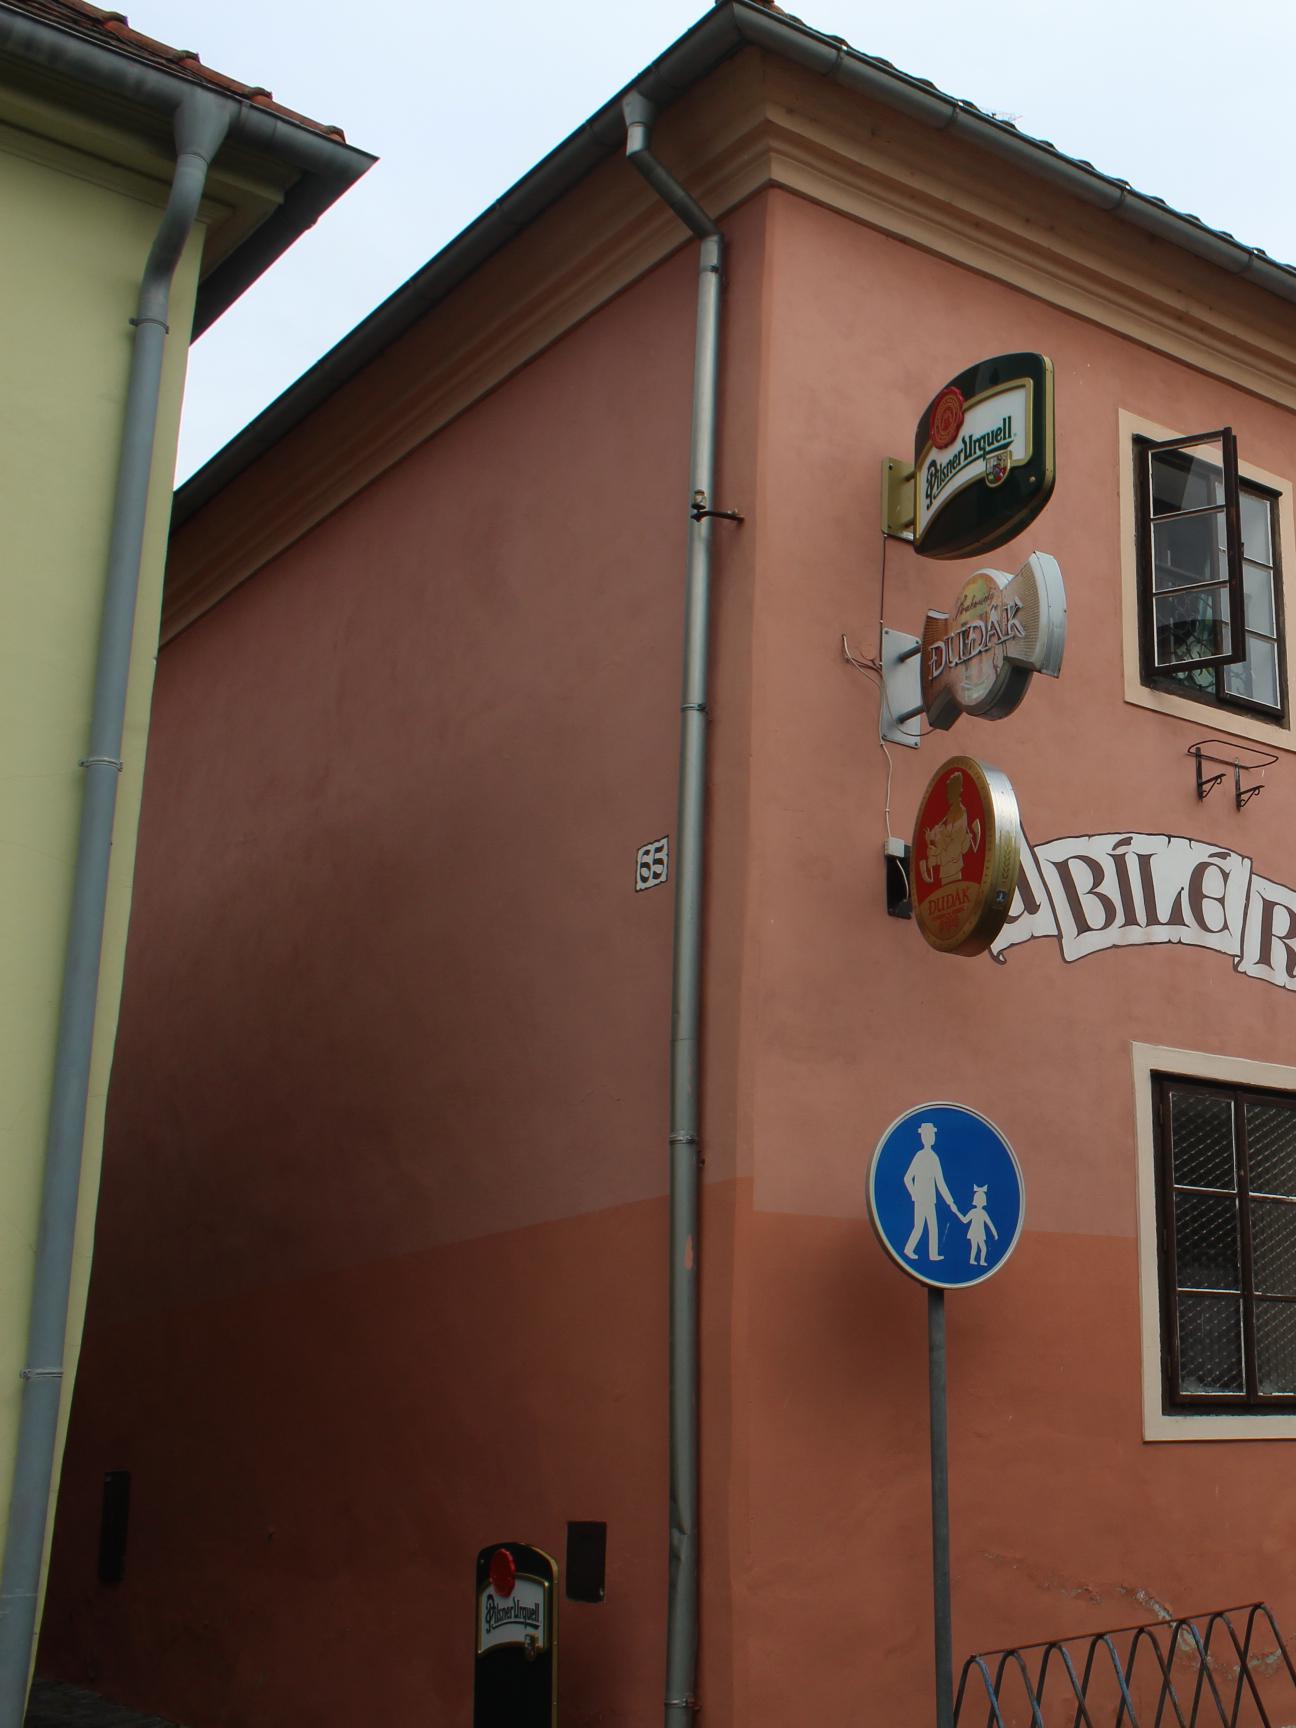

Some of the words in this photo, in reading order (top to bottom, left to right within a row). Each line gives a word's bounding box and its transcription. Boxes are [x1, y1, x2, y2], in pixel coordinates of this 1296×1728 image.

[925, 451, 965, 511] Pilsner
[963, 415, 1013, 461] Urquell
[640, 844, 665, 883] 65
[1046, 836, 1232, 940] BÍLÉ
[486, 1594, 513, 1634] Pilsner
[512, 1596, 540, 1629] Urquell
